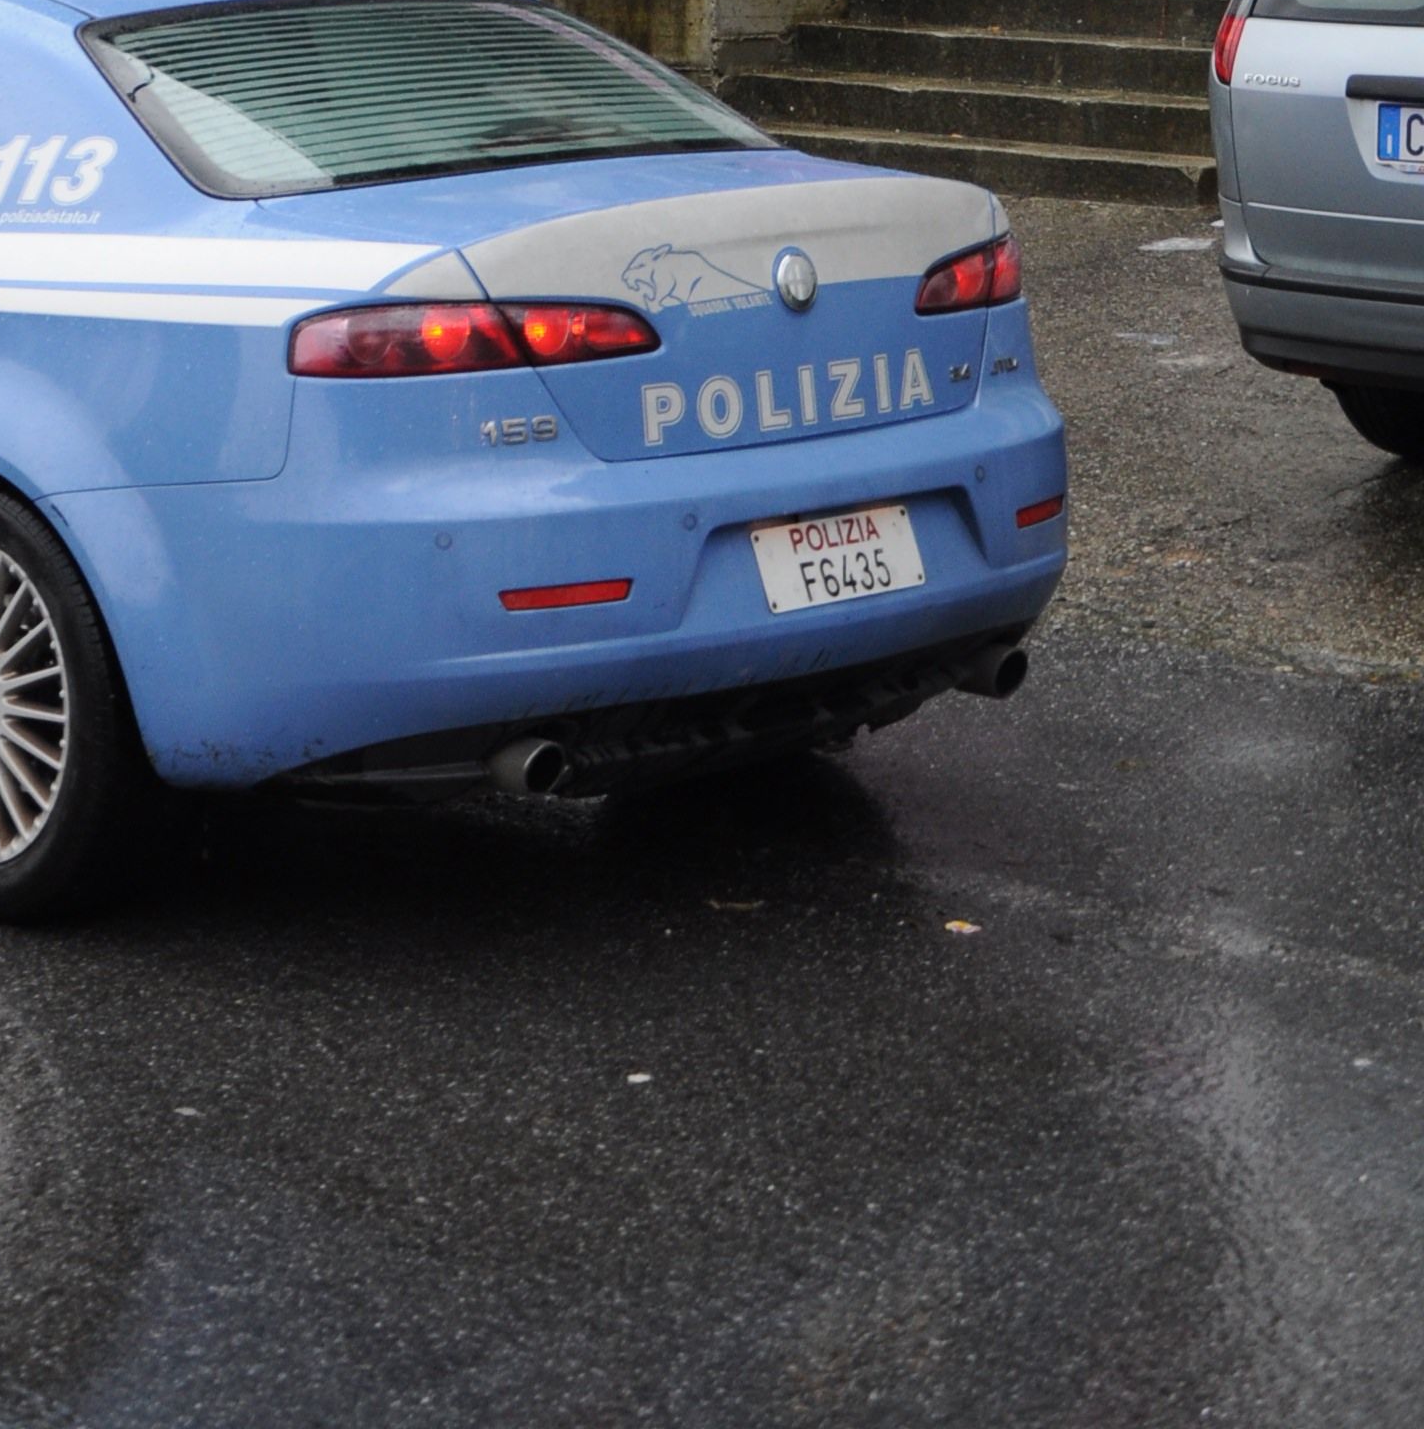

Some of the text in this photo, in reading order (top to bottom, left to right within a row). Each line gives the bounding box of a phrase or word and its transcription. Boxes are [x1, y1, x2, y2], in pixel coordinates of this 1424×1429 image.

[1244, 73, 1300, 87] FOCUS
[641, 347, 935, 447] POLIZIA
[480, 415, 558, 446] 159
[789, 515, 880, 555] POLIZIA
[800, 548, 892, 603] F6435
